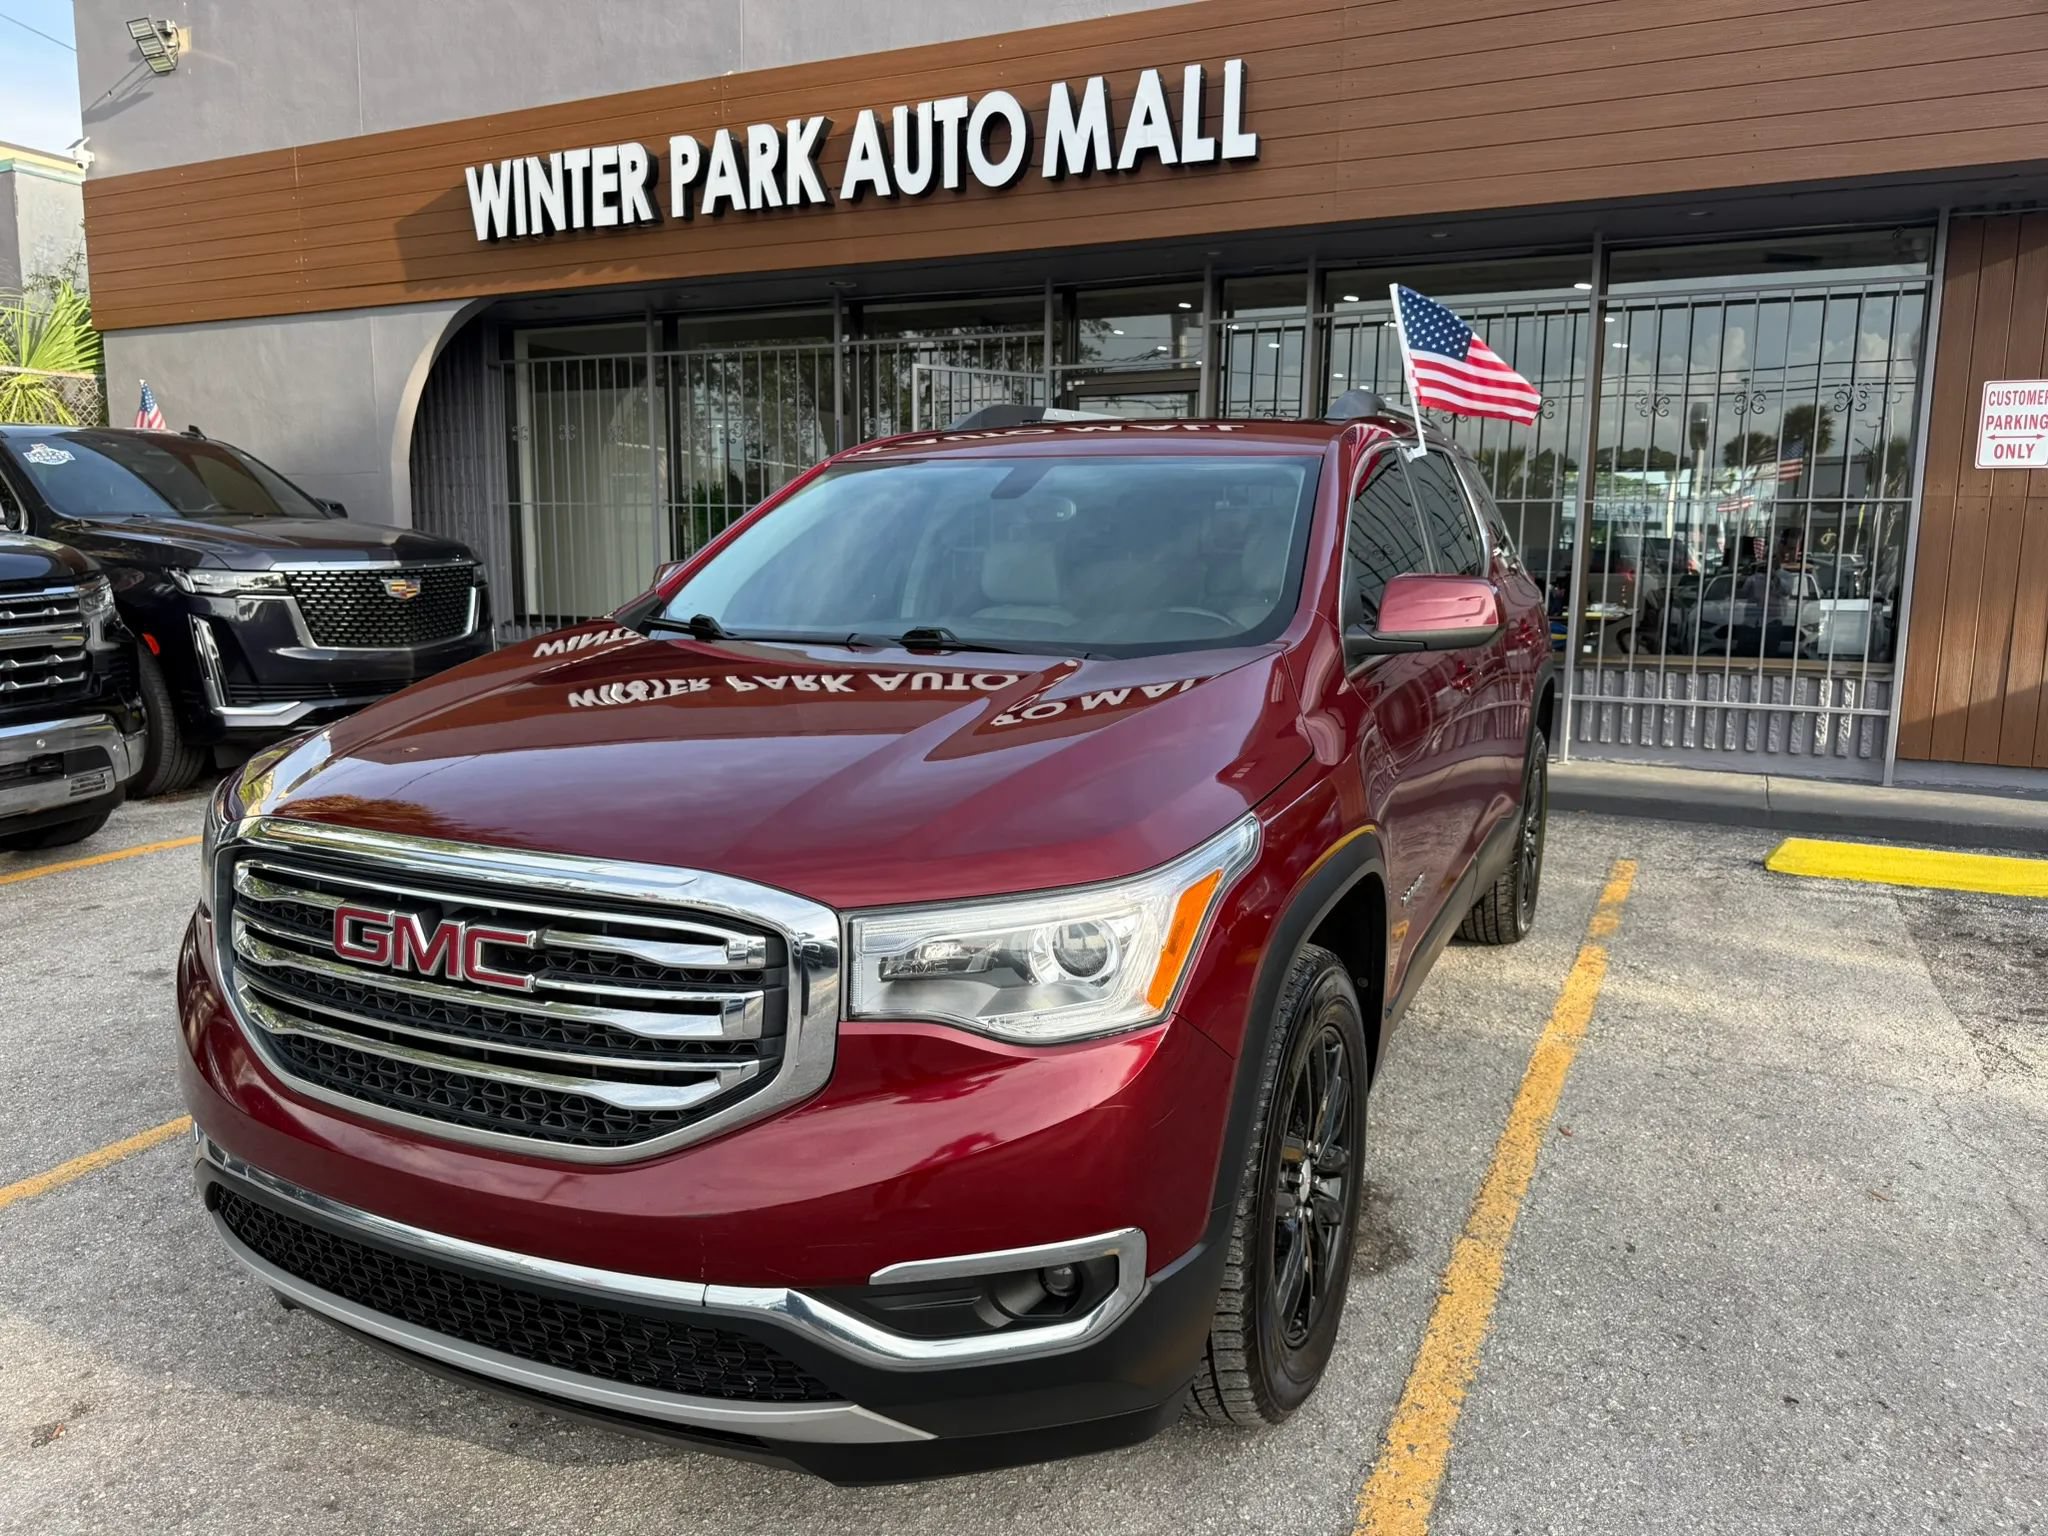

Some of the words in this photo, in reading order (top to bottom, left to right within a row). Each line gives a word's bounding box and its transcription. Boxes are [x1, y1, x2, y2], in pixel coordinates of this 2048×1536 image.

[465, 142, 655, 241] WINTER
[670, 116, 828, 218] PARK
[840, 90, 1027, 200] AUTO
[1042, 59, 1257, 178] MALL
[1986, 414, 2048, 430] PARKING
[1994, 444, 2035, 459] ONLY
[333, 903, 537, 993] GMC
